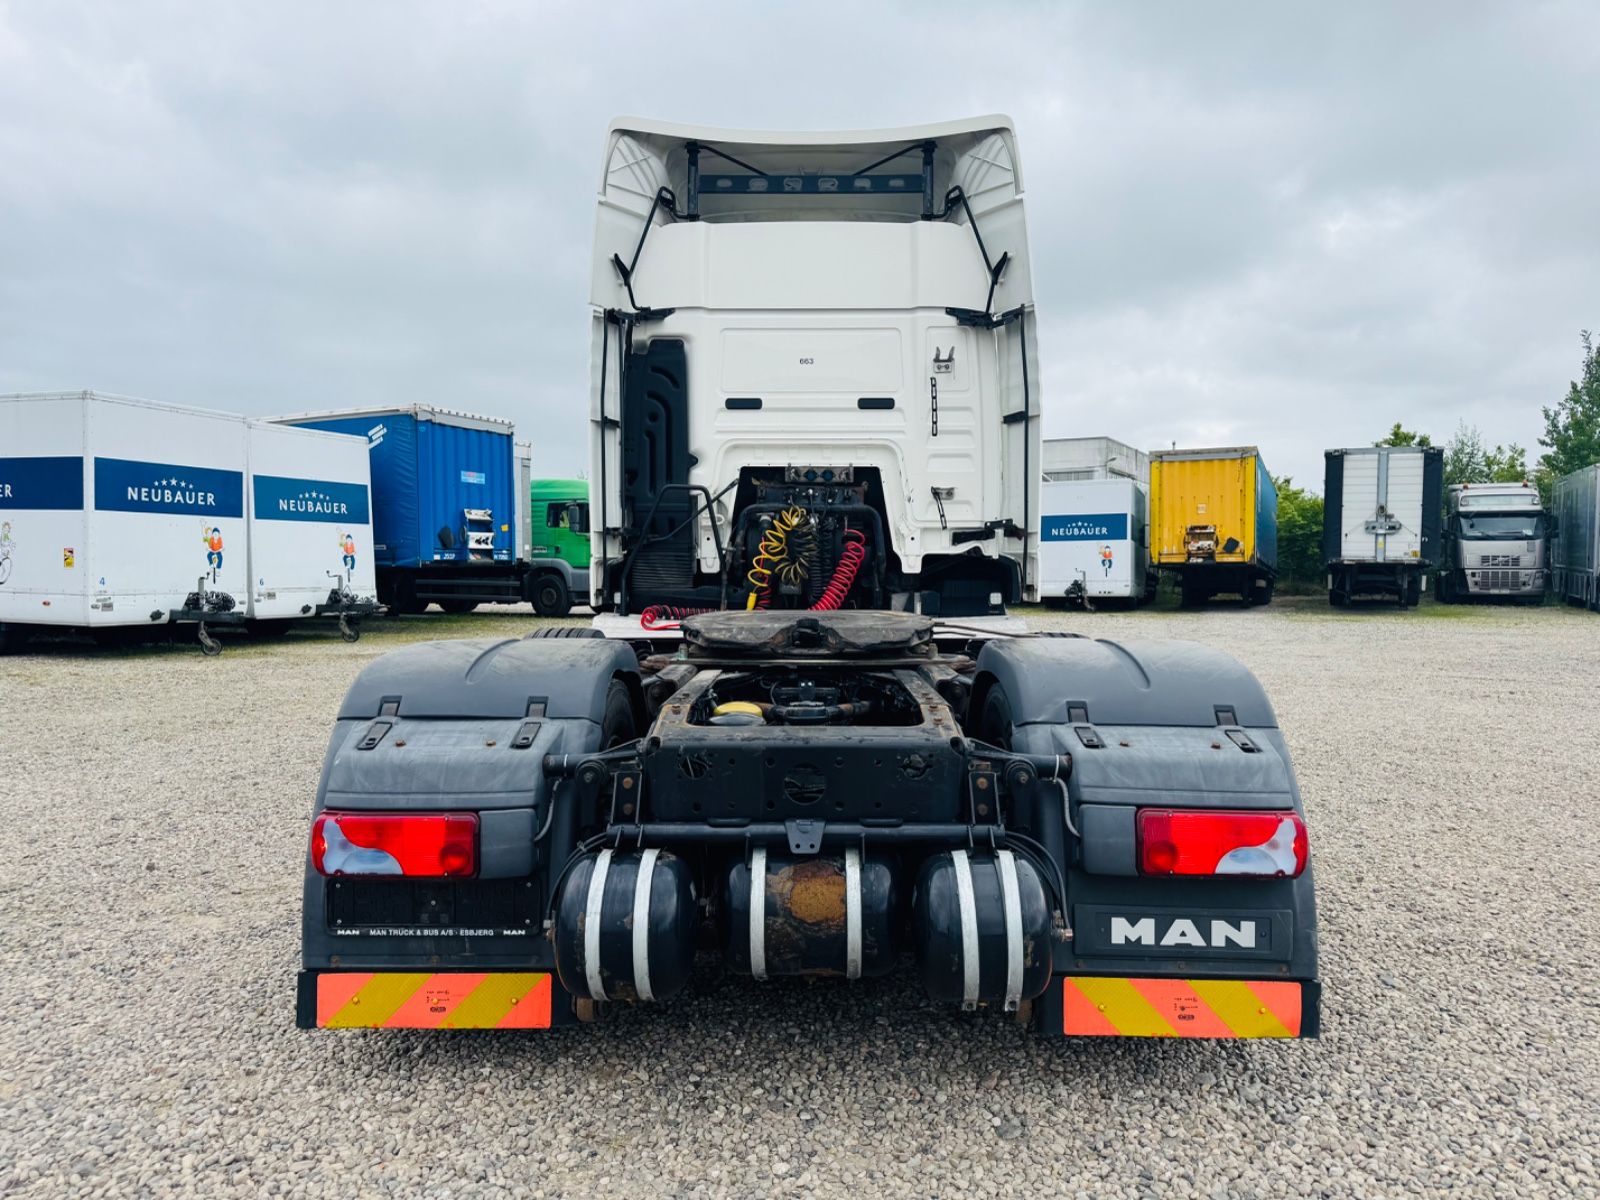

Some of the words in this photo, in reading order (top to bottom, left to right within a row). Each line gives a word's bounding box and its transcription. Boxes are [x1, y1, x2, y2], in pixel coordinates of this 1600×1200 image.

[127, 484, 216, 506] NEUBAUER
[279, 497, 348, 515] NEUBAUER
[1051, 526, 1108, 537] NEUBAUER
[99, 576, 106, 586] 4
[369, 928, 388, 937] MAN
[389, 928, 415, 937] TRUCK
[424, 928, 439, 937] BUS
[440, 928, 454, 937] A/S
[460, 928, 494, 937] ESBJERG
[1110, 917, 1256, 949] MAN
